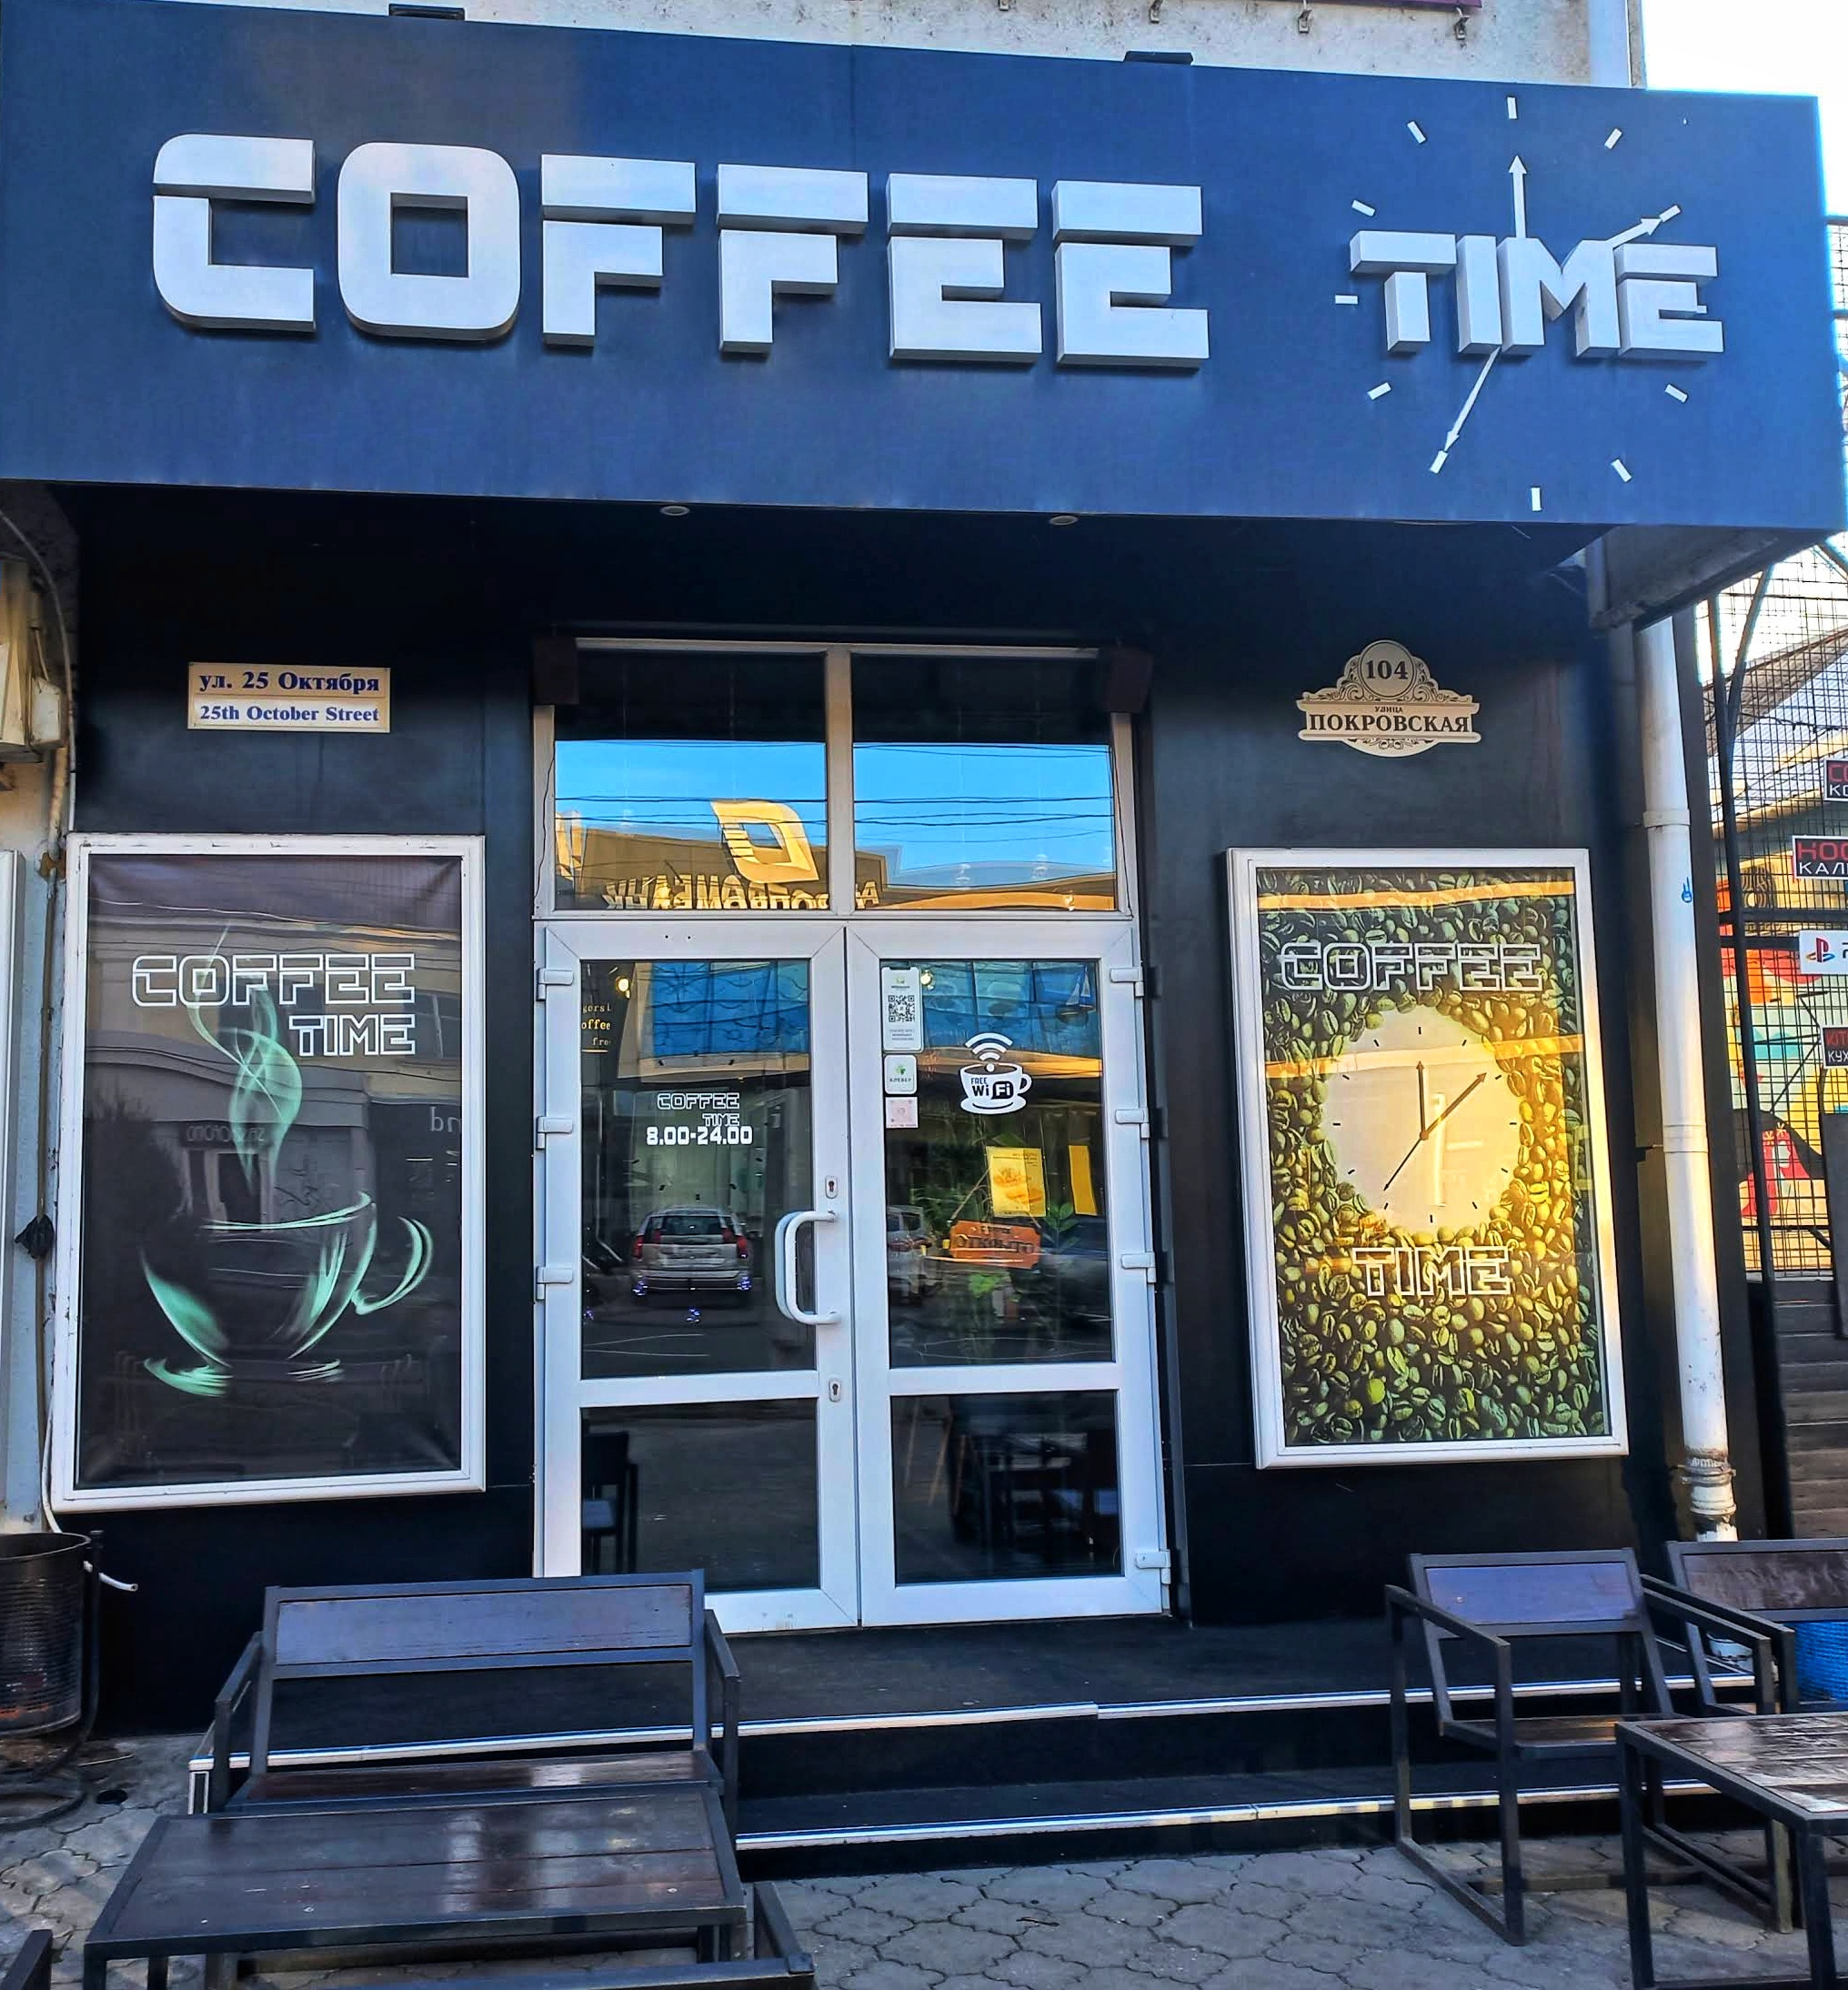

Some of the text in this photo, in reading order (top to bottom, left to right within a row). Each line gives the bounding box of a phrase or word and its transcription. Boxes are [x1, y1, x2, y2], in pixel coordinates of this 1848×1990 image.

[153, 134, 1723, 367] COFFEE TIME
[1366, 660, 1408, 679] 104
[199, 672, 379, 694] ул. 25 Октября
[200, 706, 379, 721] 25th October Street
[1310, 714, 1470, 732] ПОКРОВСКАЯ
[1799, 861, 1848, 875] КАЛ
[1281, 941, 1545, 992] COFFEE
[132, 953, 415, 1006] COFFEE
[288, 1014, 415, 1056] TIME
[970, 1077, 988, 1085] FREE
[971, 1083, 1011, 1096] Wi Fi
[657, 1092, 740, 1110] COFFEE
[702, 1113, 740, 1127] TIME
[646, 1126, 753, 1146] 8.00-24.00
[1352, 1247, 1511, 1297] TIME
